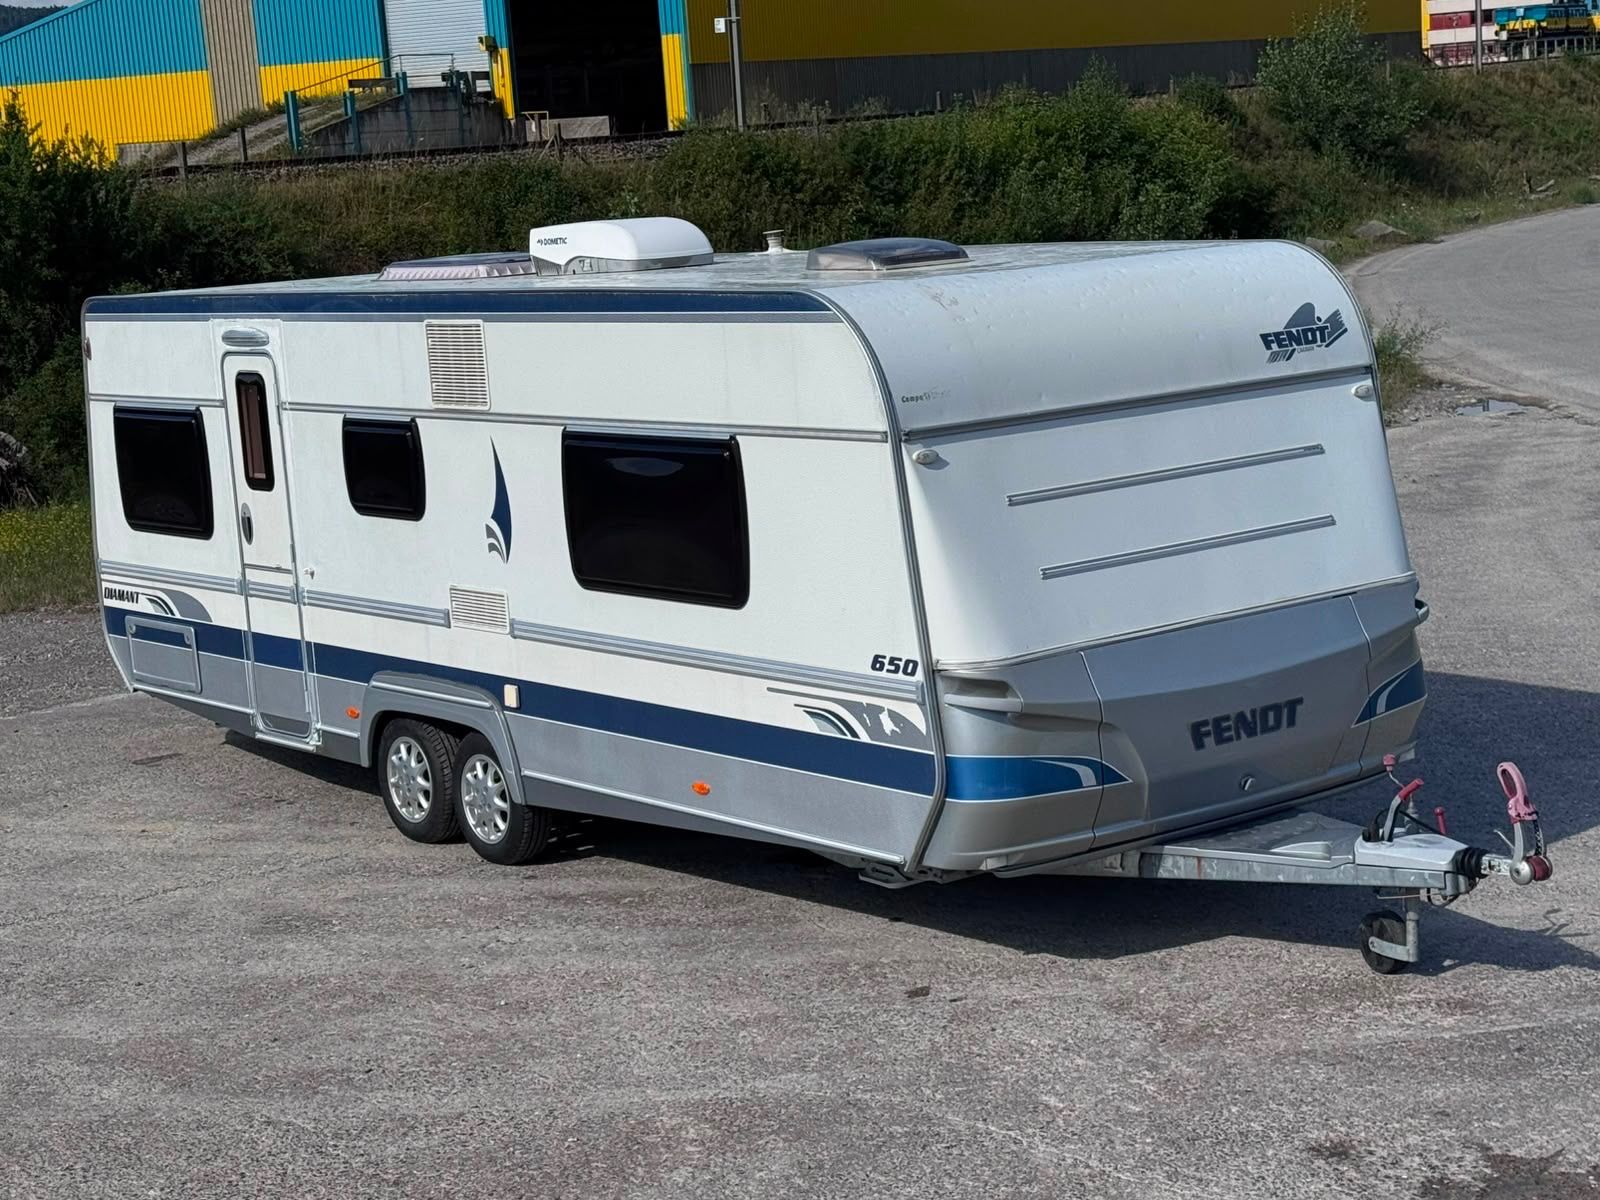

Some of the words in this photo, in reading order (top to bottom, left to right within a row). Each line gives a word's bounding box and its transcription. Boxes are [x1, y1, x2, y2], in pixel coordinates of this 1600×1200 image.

[543, 237, 568, 246] DOMETIC
[1259, 325, 1330, 351] FENDT
[104, 586, 140, 604] DIAMANT
[871, 654, 919, 677] 650
[1190, 696, 1304, 752] FENDT
